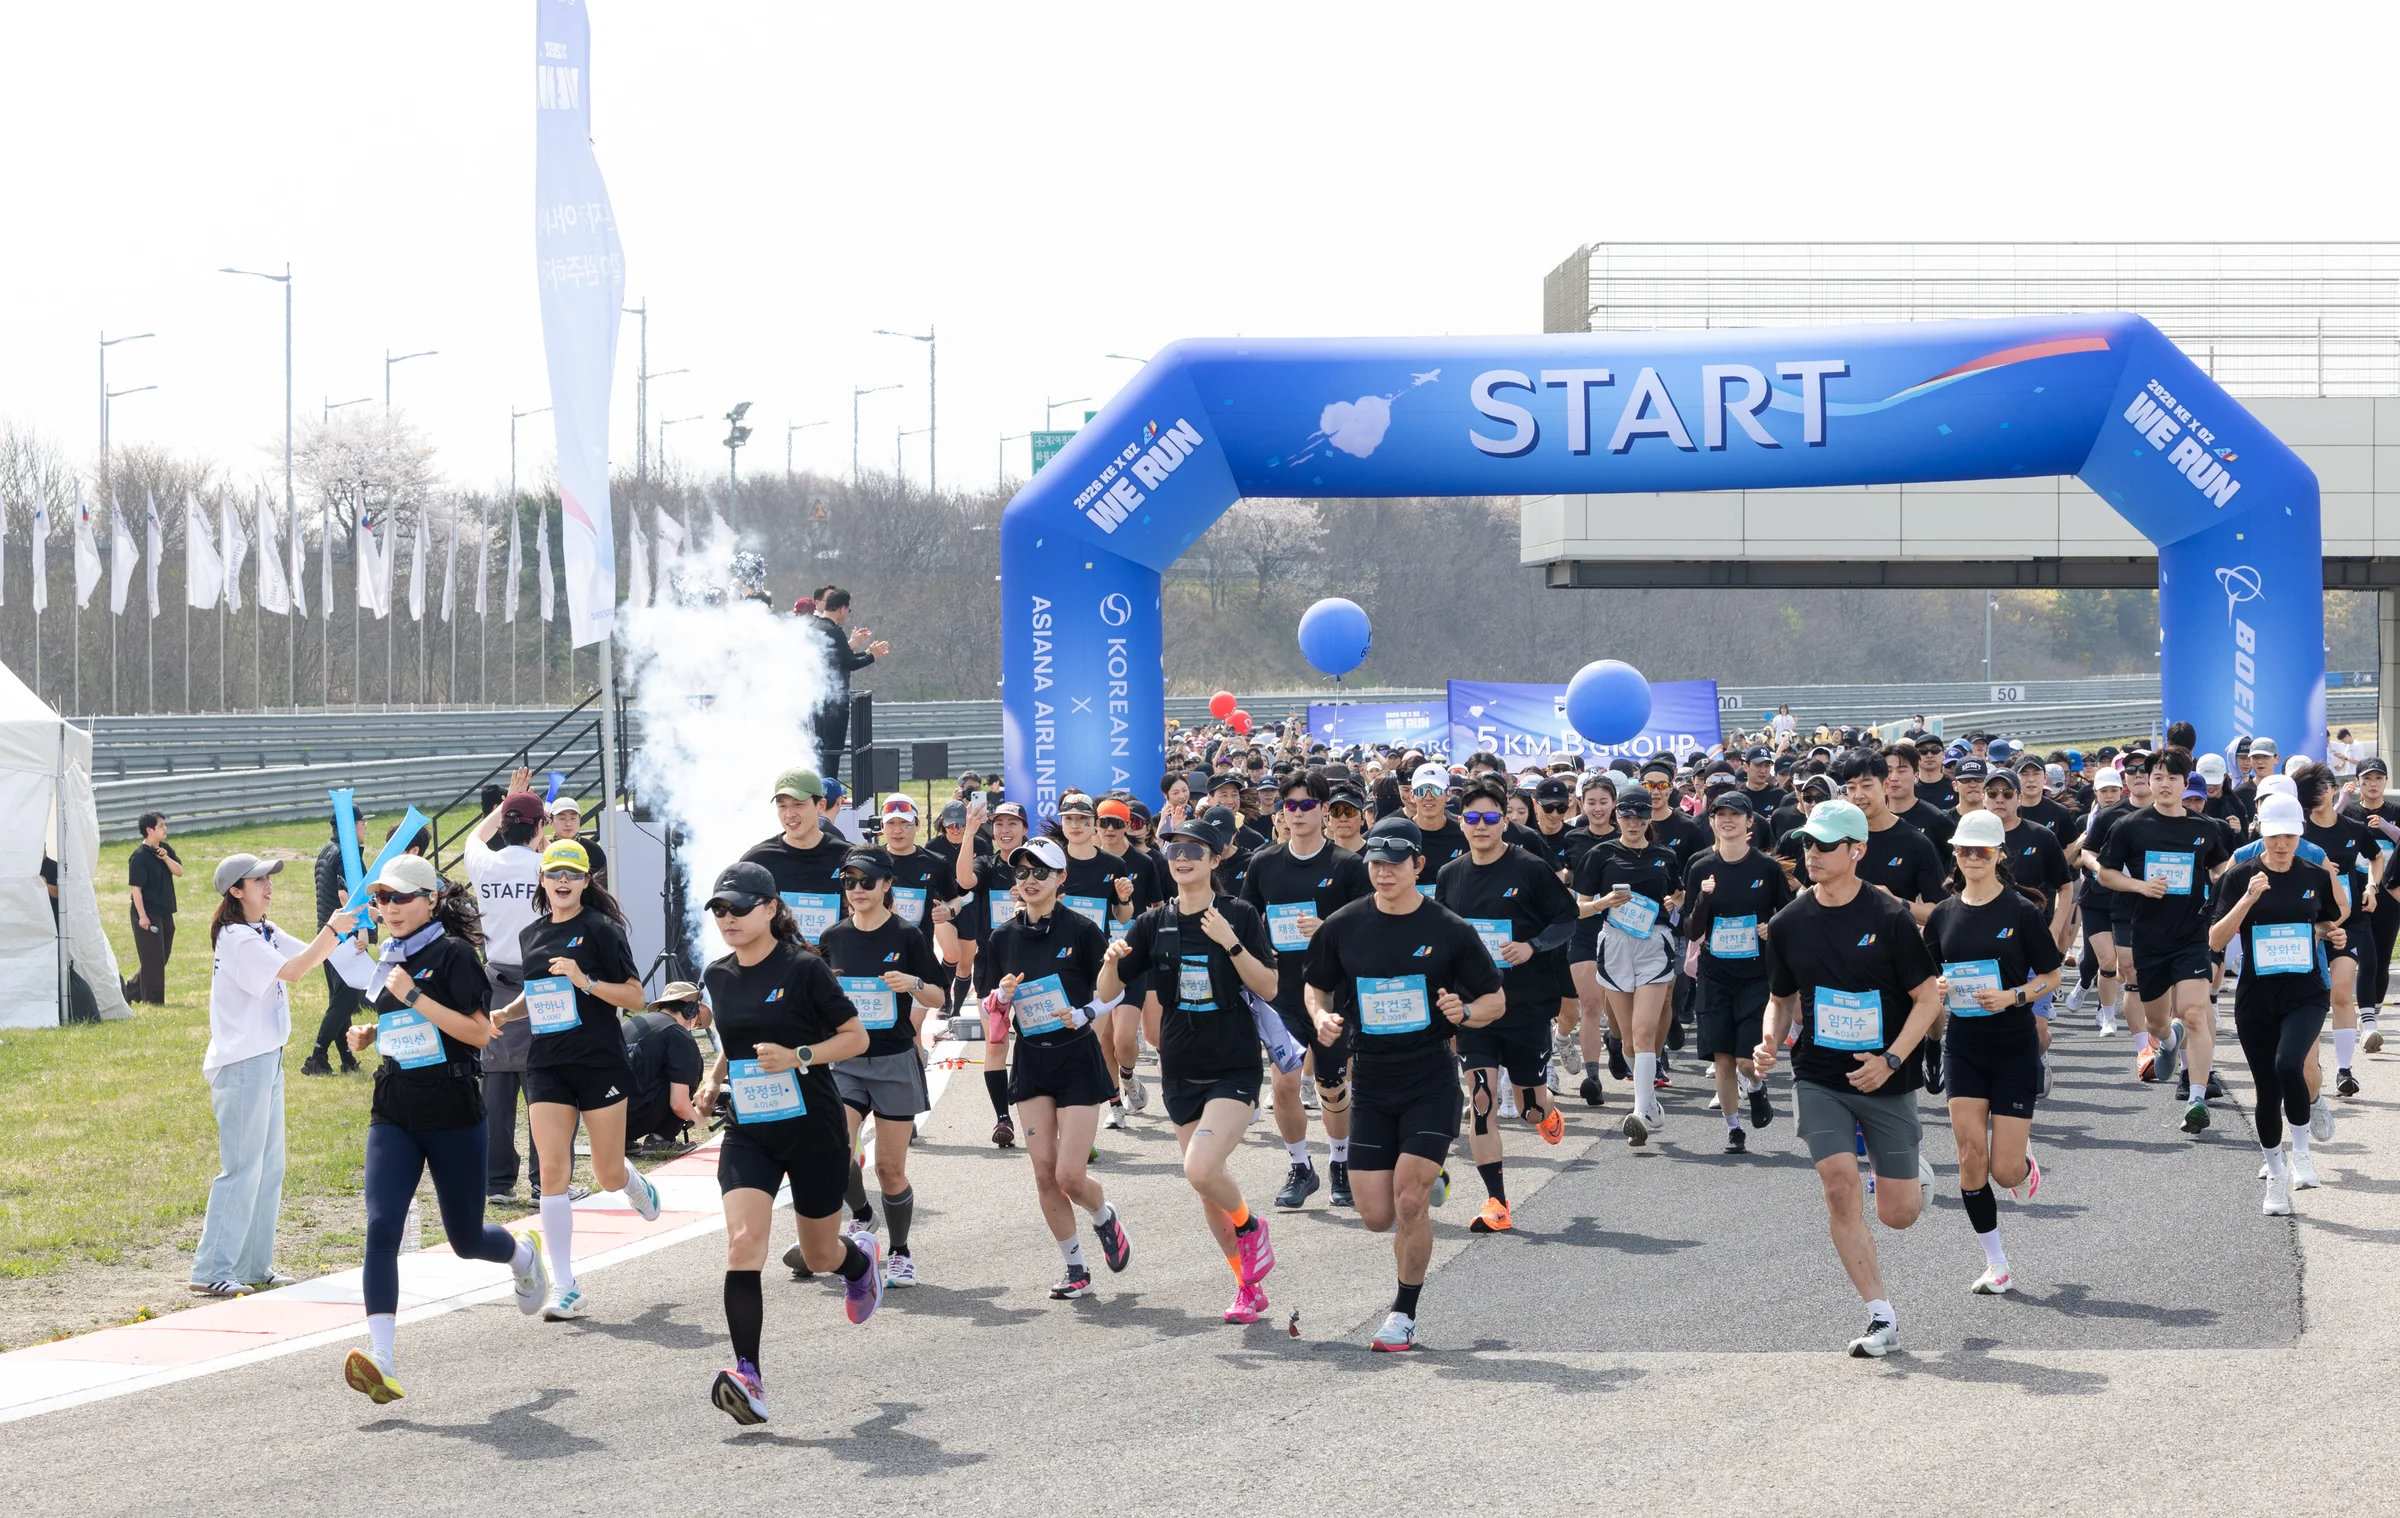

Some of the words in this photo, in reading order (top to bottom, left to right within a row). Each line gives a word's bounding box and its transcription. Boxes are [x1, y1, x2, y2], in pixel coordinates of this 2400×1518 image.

[1470, 359, 1850, 458] START
[2146, 379, 2177, 409] 2026
[2173, 404, 2192, 424] KE
[2187, 418, 2201, 432] X
[2197, 427, 2215, 446] OZ
[2123, 391, 2181, 451] WE
[2167, 436, 2241, 509] RUN
[1073, 479, 1103, 510] 2026
[1099, 464, 1118, 484] KE
[1113, 456, 1127, 470] X
[1122, 442, 1141, 461] OZ
[1086, 476, 1145, 535] WE
[1131, 417, 1204, 491] RUN
[1032, 595, 1054, 692] ASIANA
[2234, 618, 2256, 740] BOEIN
[1107, 638, 1130, 757] KOREAN
[1997, 687, 2017, 701] 50
[1386, 718, 1404, 729] WE
[1405, 717, 1430, 729] RUN
[1560, 729, 1586, 757] B
[1589, 733, 1696, 758] GROUP
[1034, 701, 1057, 818] AIRLINES
[551, 850, 580, 860] HOKA
[481, 883, 537, 899] STAFF
[896, 904, 916, 914] 지훈
[1278, 923, 1296, 934] 채웅
[534, 999, 565, 1014] 방하나
[1022, 999, 1056, 1017] 황지윤
[1373, 997, 1412, 1014] 김건국
[1828, 1013, 1867, 1030] 임지수
[390, 1032, 427, 1050] 김민선
[1834, 1030, 1860, 1038] A0147
[742, 1082, 783, 1101] 장정희
[753, 1100, 779, 1109] A0149
